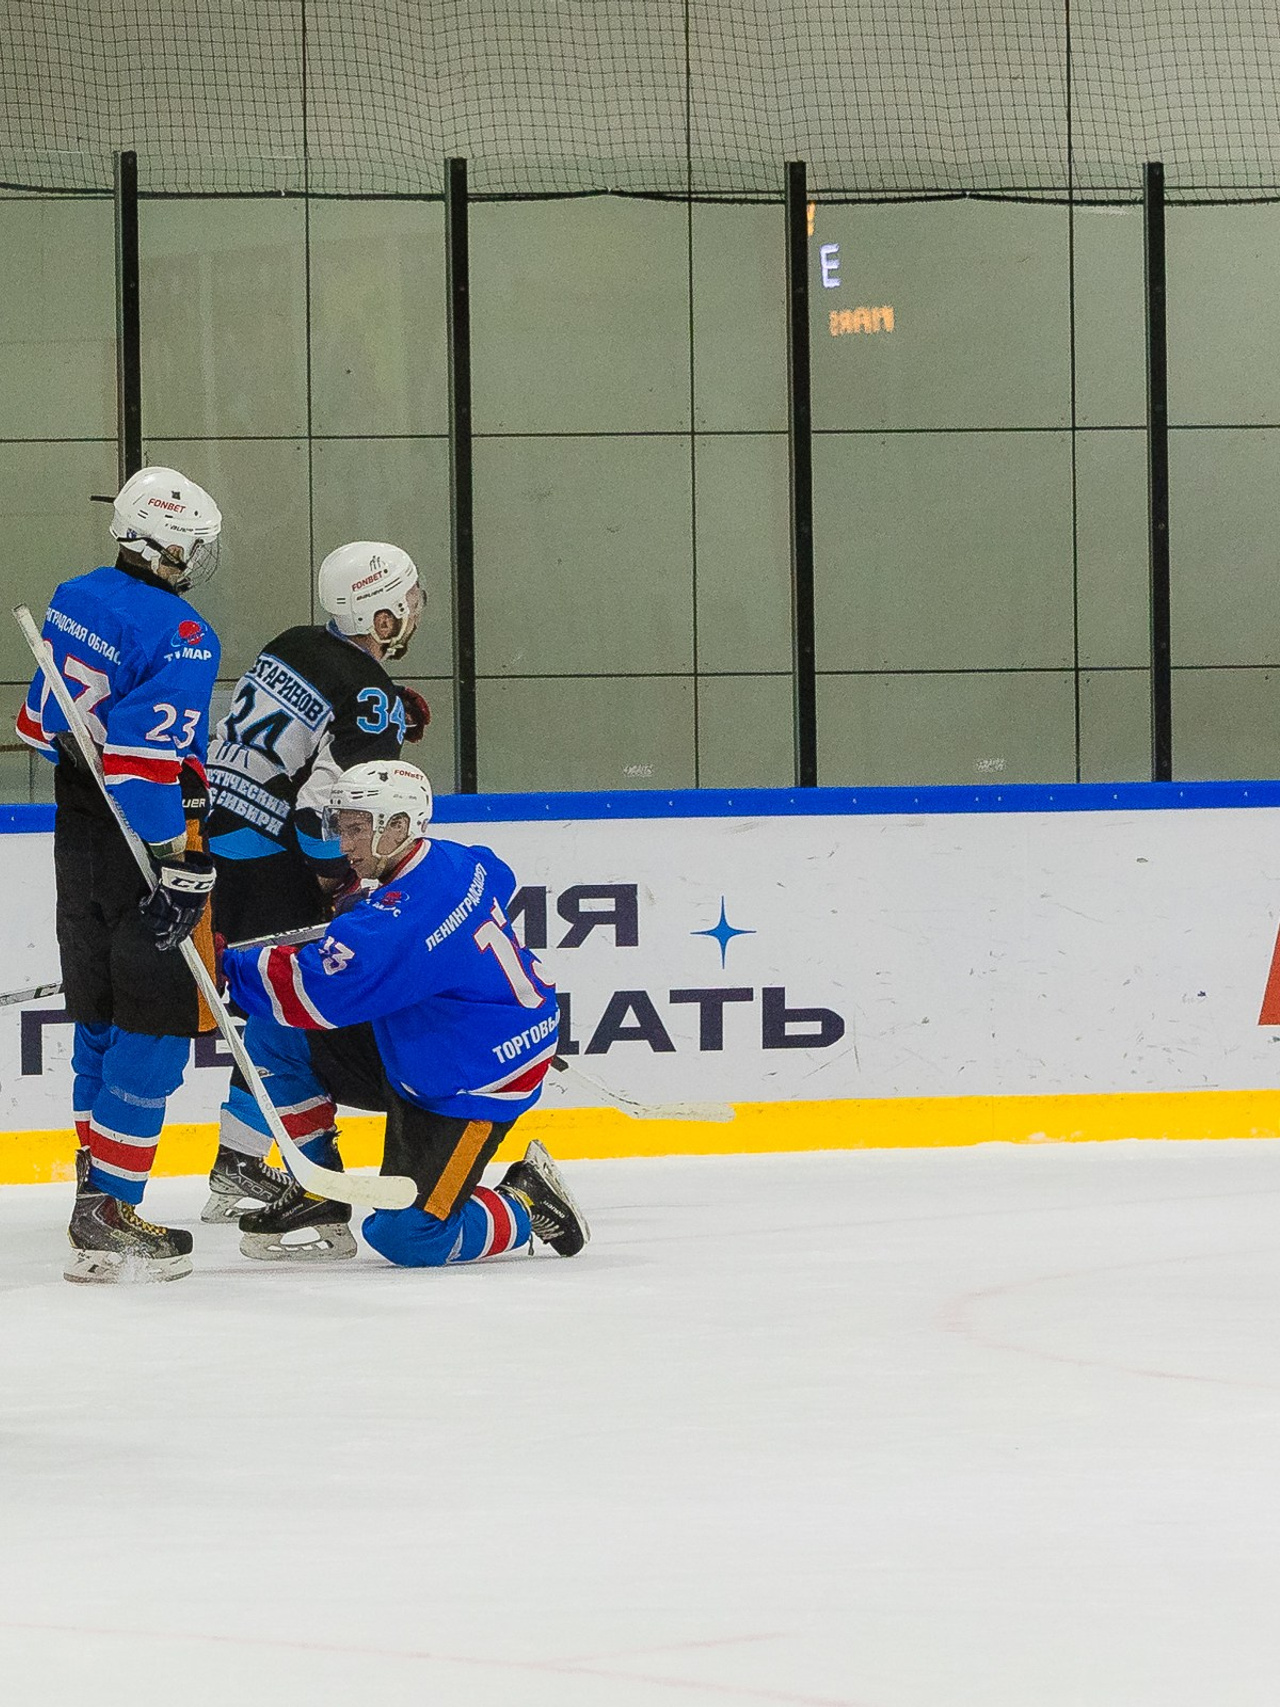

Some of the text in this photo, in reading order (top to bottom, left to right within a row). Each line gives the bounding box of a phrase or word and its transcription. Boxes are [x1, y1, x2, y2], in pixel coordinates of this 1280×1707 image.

[147, 498, 186, 513] FONBET
[351, 570, 383, 593] FONBET
[356, 687, 407, 745] 34
[145, 702, 202, 750] 23
[182, 798, 206, 808] UER
[171, 876, 216, 890] CC
